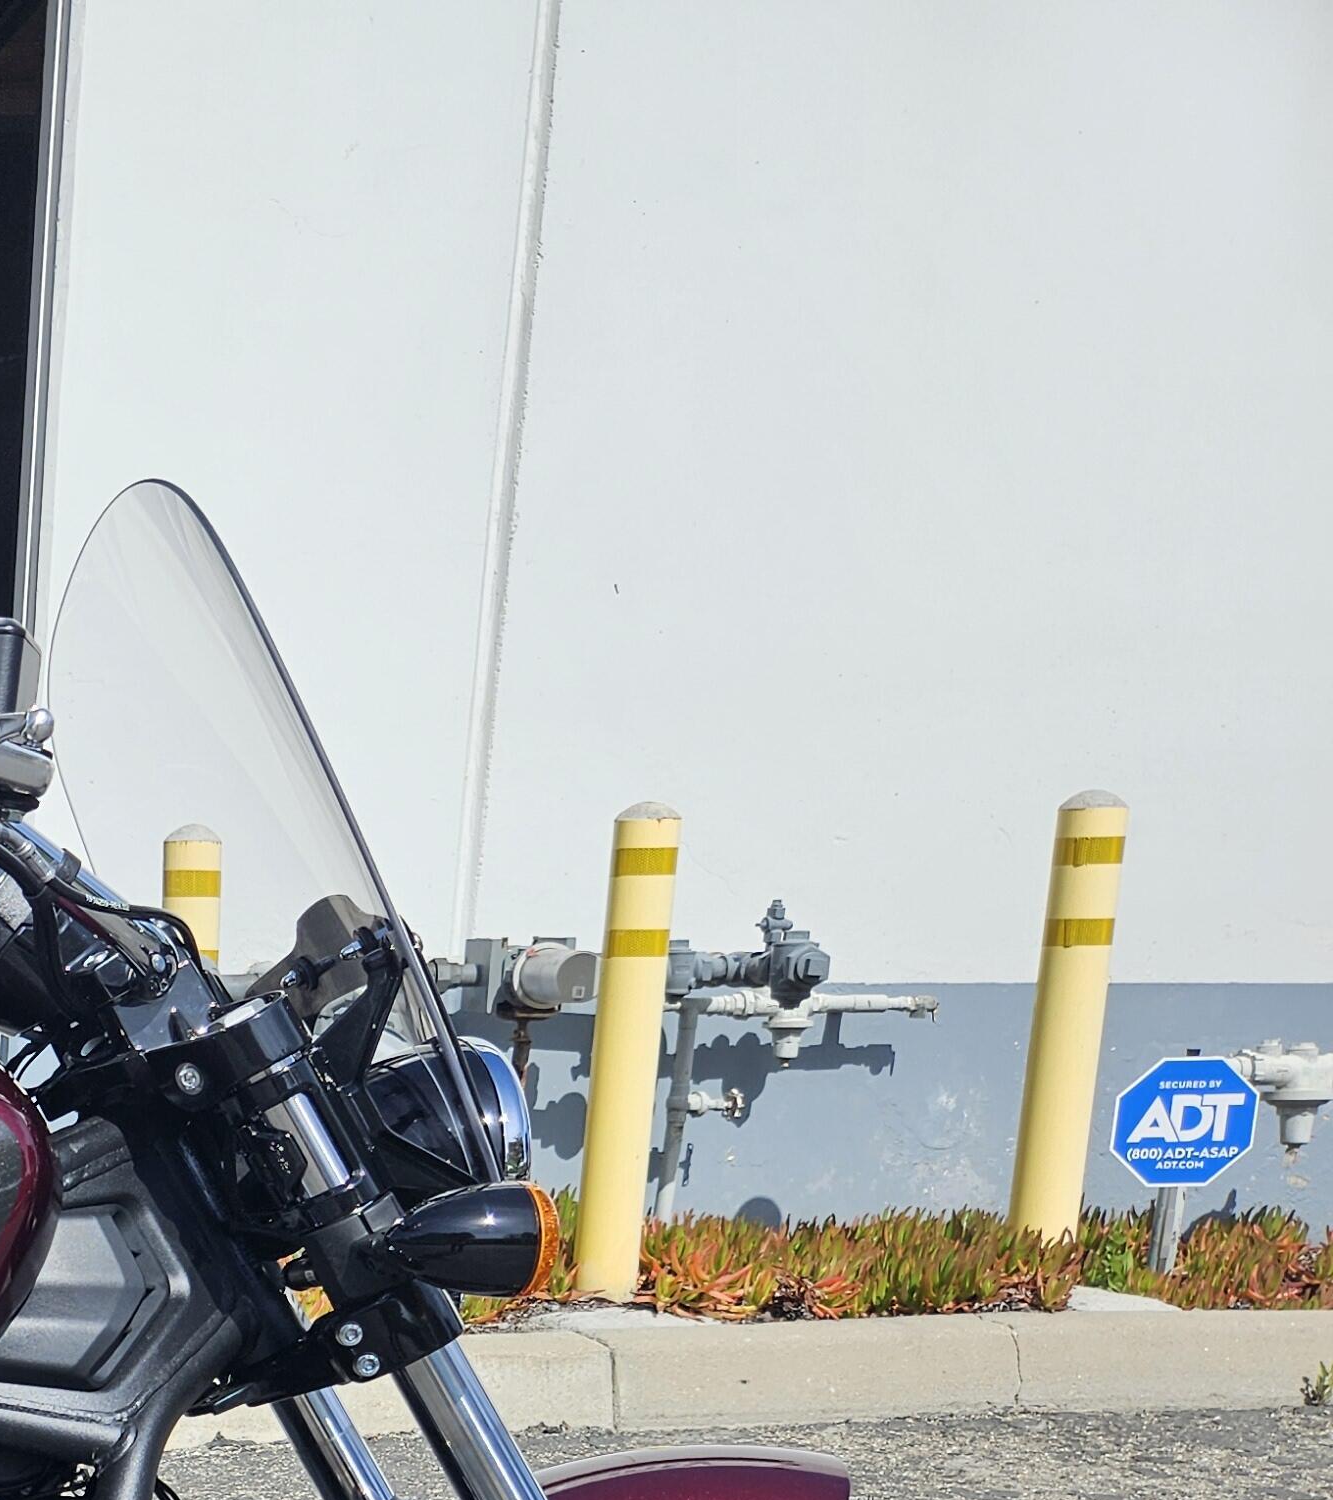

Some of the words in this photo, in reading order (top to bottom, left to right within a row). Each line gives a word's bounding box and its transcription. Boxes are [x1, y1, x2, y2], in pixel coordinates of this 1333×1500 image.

[1159, 1080, 1206, 1090] SECURED
[1208, 1079, 1223, 1089] BY
[1126, 1093, 1246, 1144] ADT
[1126, 1147, 1163, 1162] (800)
[1163, 1146, 1239, 1160] ADT-ASAP
[1155, 1160, 1204, 1170] ADT.COM
